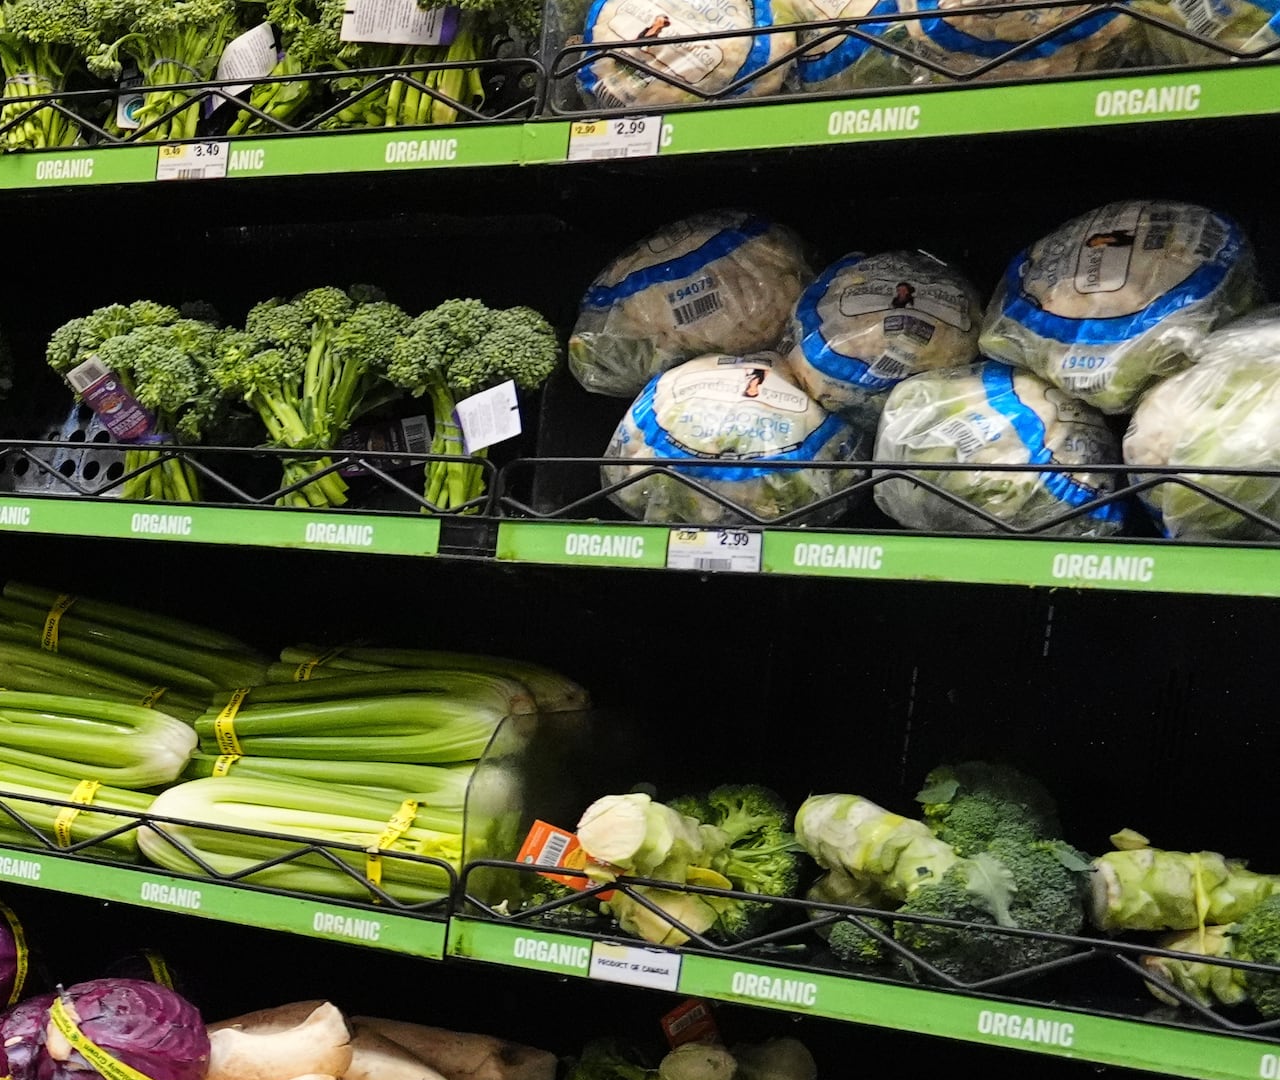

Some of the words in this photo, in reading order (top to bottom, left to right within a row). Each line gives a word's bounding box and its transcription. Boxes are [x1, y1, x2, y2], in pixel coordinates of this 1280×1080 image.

[1095, 84, 1201, 116] ORGANIC
[828, 105, 921, 135] ORGANIC
[228, 147, 266, 173] ANIC
[385, 139, 457, 163] ORGANIC
[36, 158, 94, 180] ORGANIC
[667, 276, 715, 304] #94079
[130, 512, 193, 536] ORGANIC
[305, 522, 374, 547] ORGANIC
[565, 532, 644, 559] ORGANIC
[793, 542, 883, 571] ORGANIC
[1051, 553, 1155, 583] ORGANIC
[140, 881, 202, 910] ORGANIC
[312, 911, 381, 942] ORGANIC
[513, 936, 589, 969] ORGANIC
[597, 957, 629, 970] PRODUCT
[630, 963, 641, 972] OF
[731, 971, 817, 1007] ORGANIC
[976, 1009, 1075, 1047] ORGANIC
[82, 1043, 107, 1066] Grown
